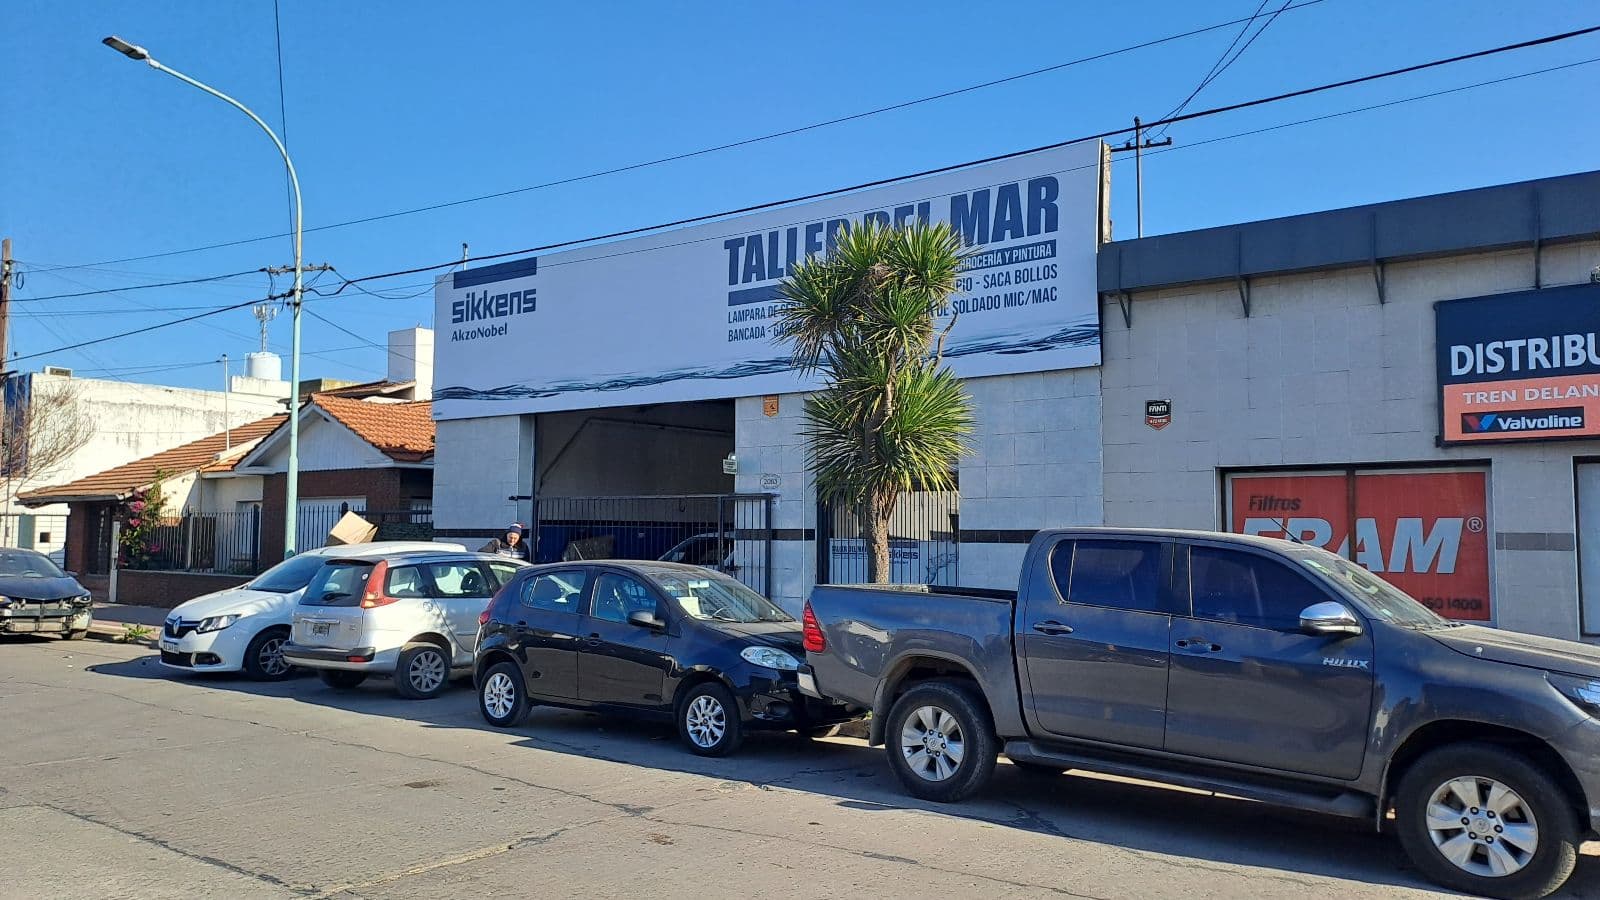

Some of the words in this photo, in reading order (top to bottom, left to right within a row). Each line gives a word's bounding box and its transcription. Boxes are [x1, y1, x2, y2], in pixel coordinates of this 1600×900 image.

[951, 176, 1060, 248] MAR
[1004, 250, 1012, 264] Y
[1012, 244, 1052, 262] PINTURA
[728, 306, 766, 324] LAMPARA
[983, 271, 1011, 289] SACA
[1015, 264, 1058, 285] BOLLOS
[452, 288, 537, 324] sikkens
[728, 326, 766, 342] BANCADA
[952, 294, 1000, 315] SOLDADO
[1004, 286, 1058, 308] MIC/MAC
[451, 322, 508, 342] AkzoNobel
[1463, 389, 1517, 404] TREN
[1525, 384, 1600, 401] DELAN
[1498, 414, 1582, 430] Valvoline
[1249, 495, 1302, 511] Filtros
